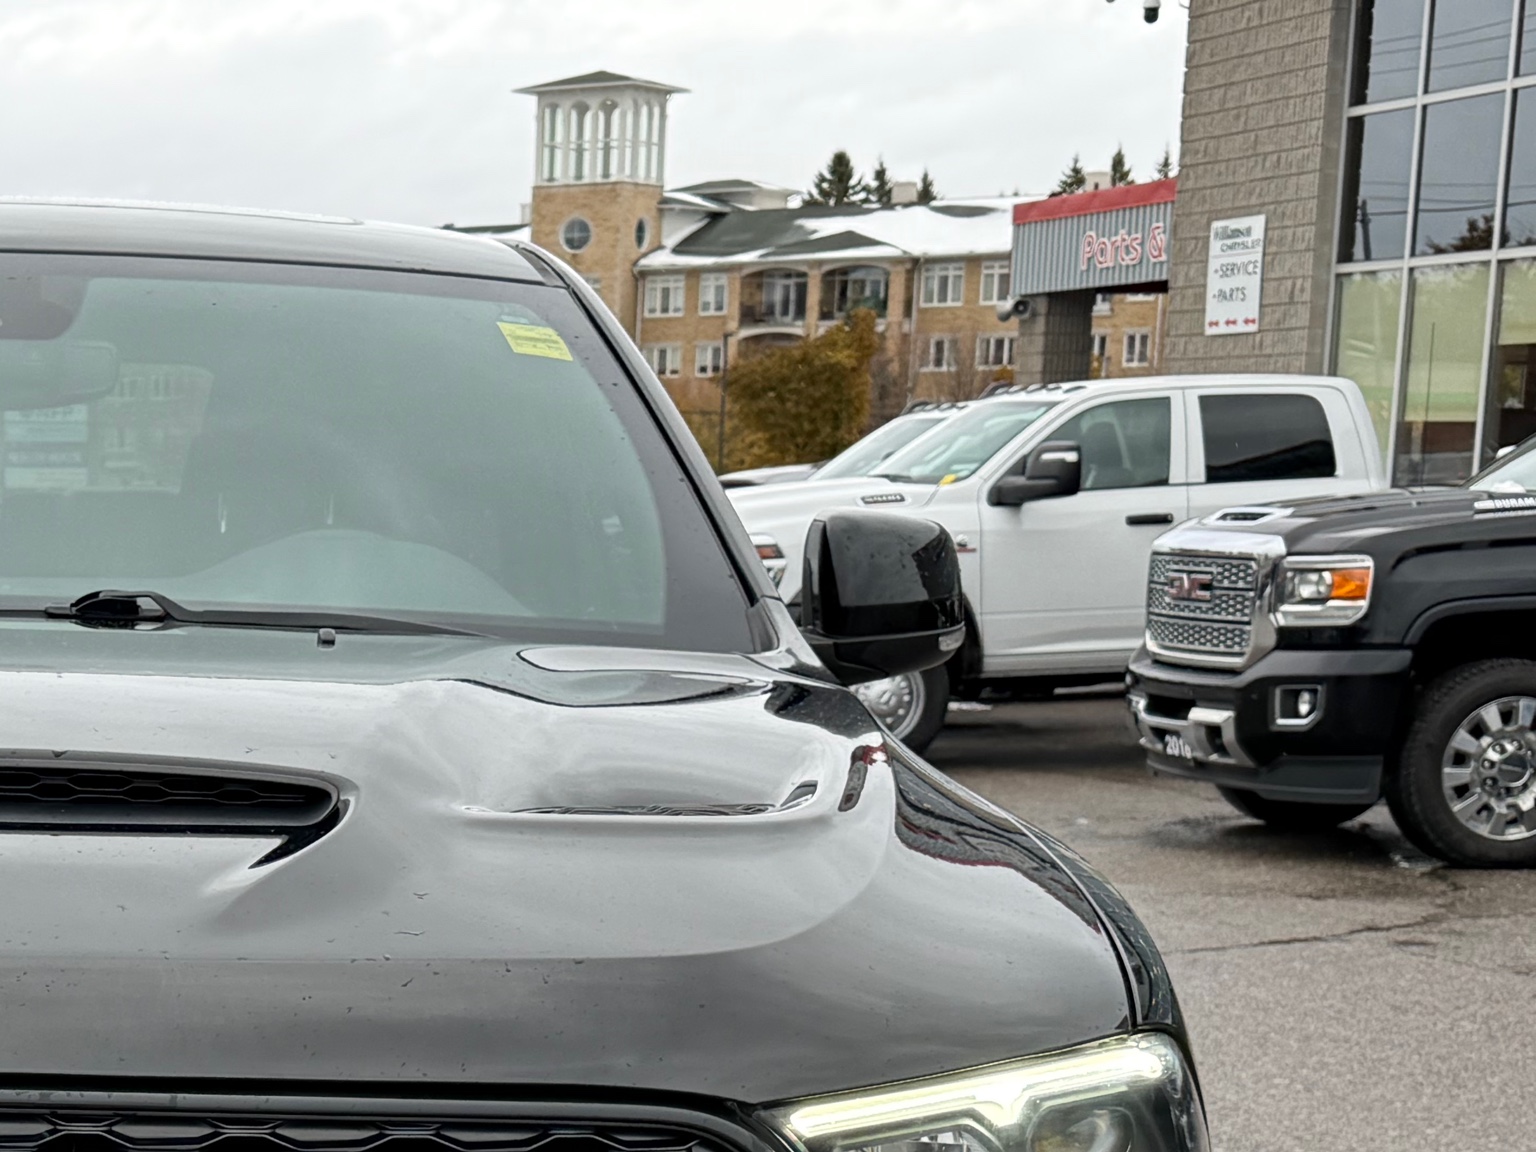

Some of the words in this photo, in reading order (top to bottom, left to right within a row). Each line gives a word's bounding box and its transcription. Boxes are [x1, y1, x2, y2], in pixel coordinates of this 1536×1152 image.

[1081, 229, 1143, 271] Parts
[1147, 222, 1167, 263] &
[1219, 260, 1259, 279] SERVICE
[1216, 287, 1247, 303] PARTS
[1494, 497, 1536, 509] DURAM
